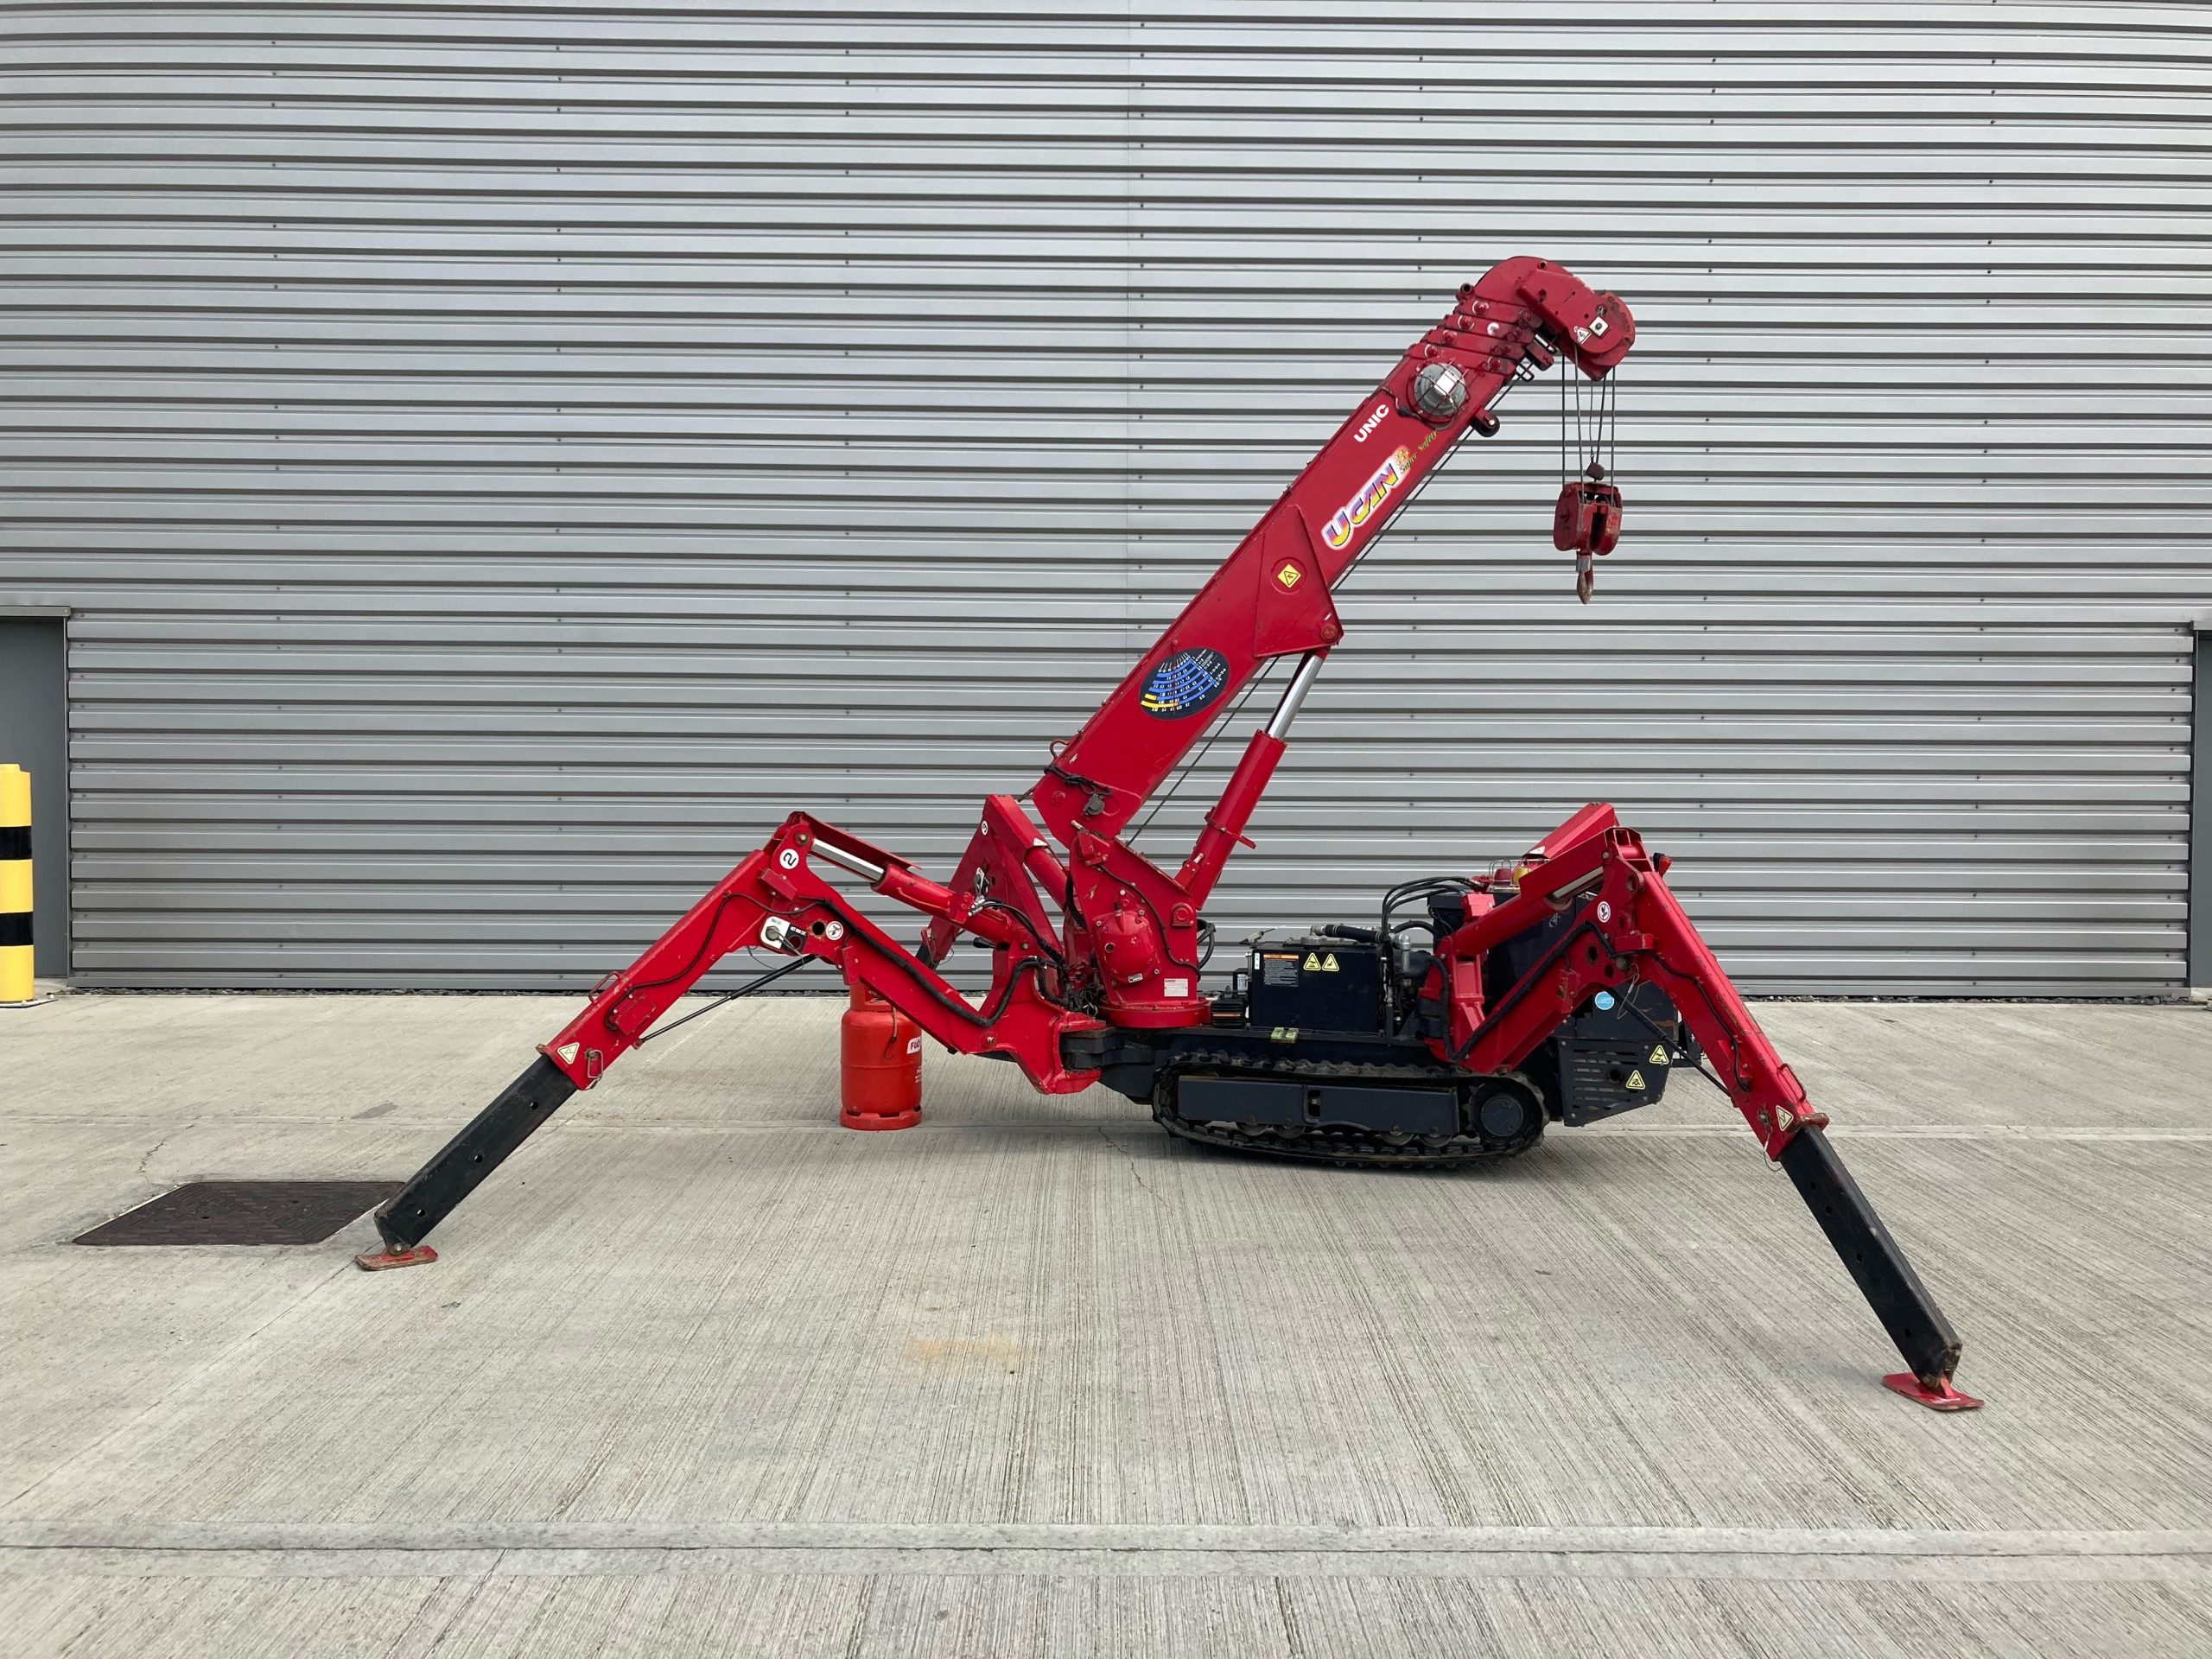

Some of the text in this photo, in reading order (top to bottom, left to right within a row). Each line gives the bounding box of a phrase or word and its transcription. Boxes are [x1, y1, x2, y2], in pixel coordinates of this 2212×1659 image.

[1353, 404, 1389, 442] UNIC
[1324, 462, 1399, 547] UCAN
[783, 852, 797, 867] 2
